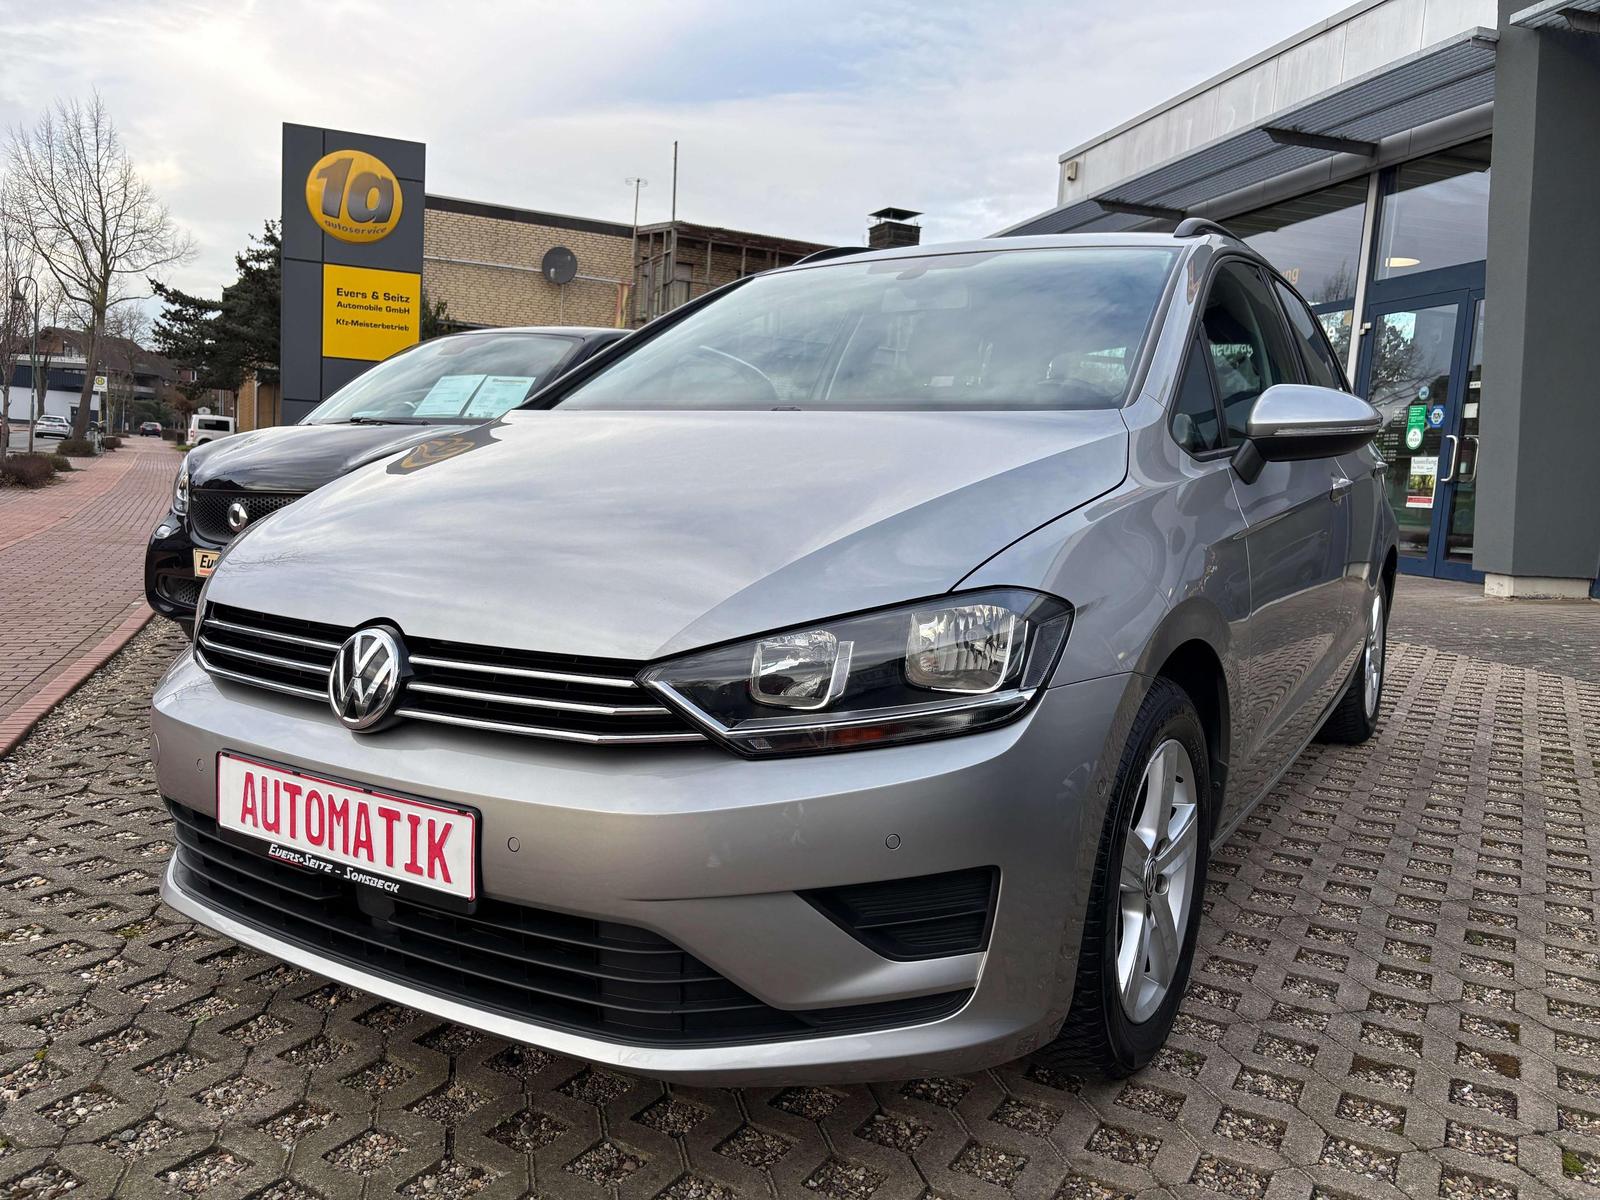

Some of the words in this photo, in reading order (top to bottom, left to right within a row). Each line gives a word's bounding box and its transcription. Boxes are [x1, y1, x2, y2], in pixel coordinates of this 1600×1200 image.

[316, 157, 395, 224] 1a
[324, 219, 388, 235] autoservice
[336, 287, 367, 299] Evers
[371, 291, 379, 300] &
[383, 292, 411, 304] Seitz
[336, 300, 383, 312] Automobile
[385, 305, 410, 315] GmbH
[335, 318, 410, 332] Kfz-Meisterbetrieb
[240, 771, 453, 884] AUTOMATIK
